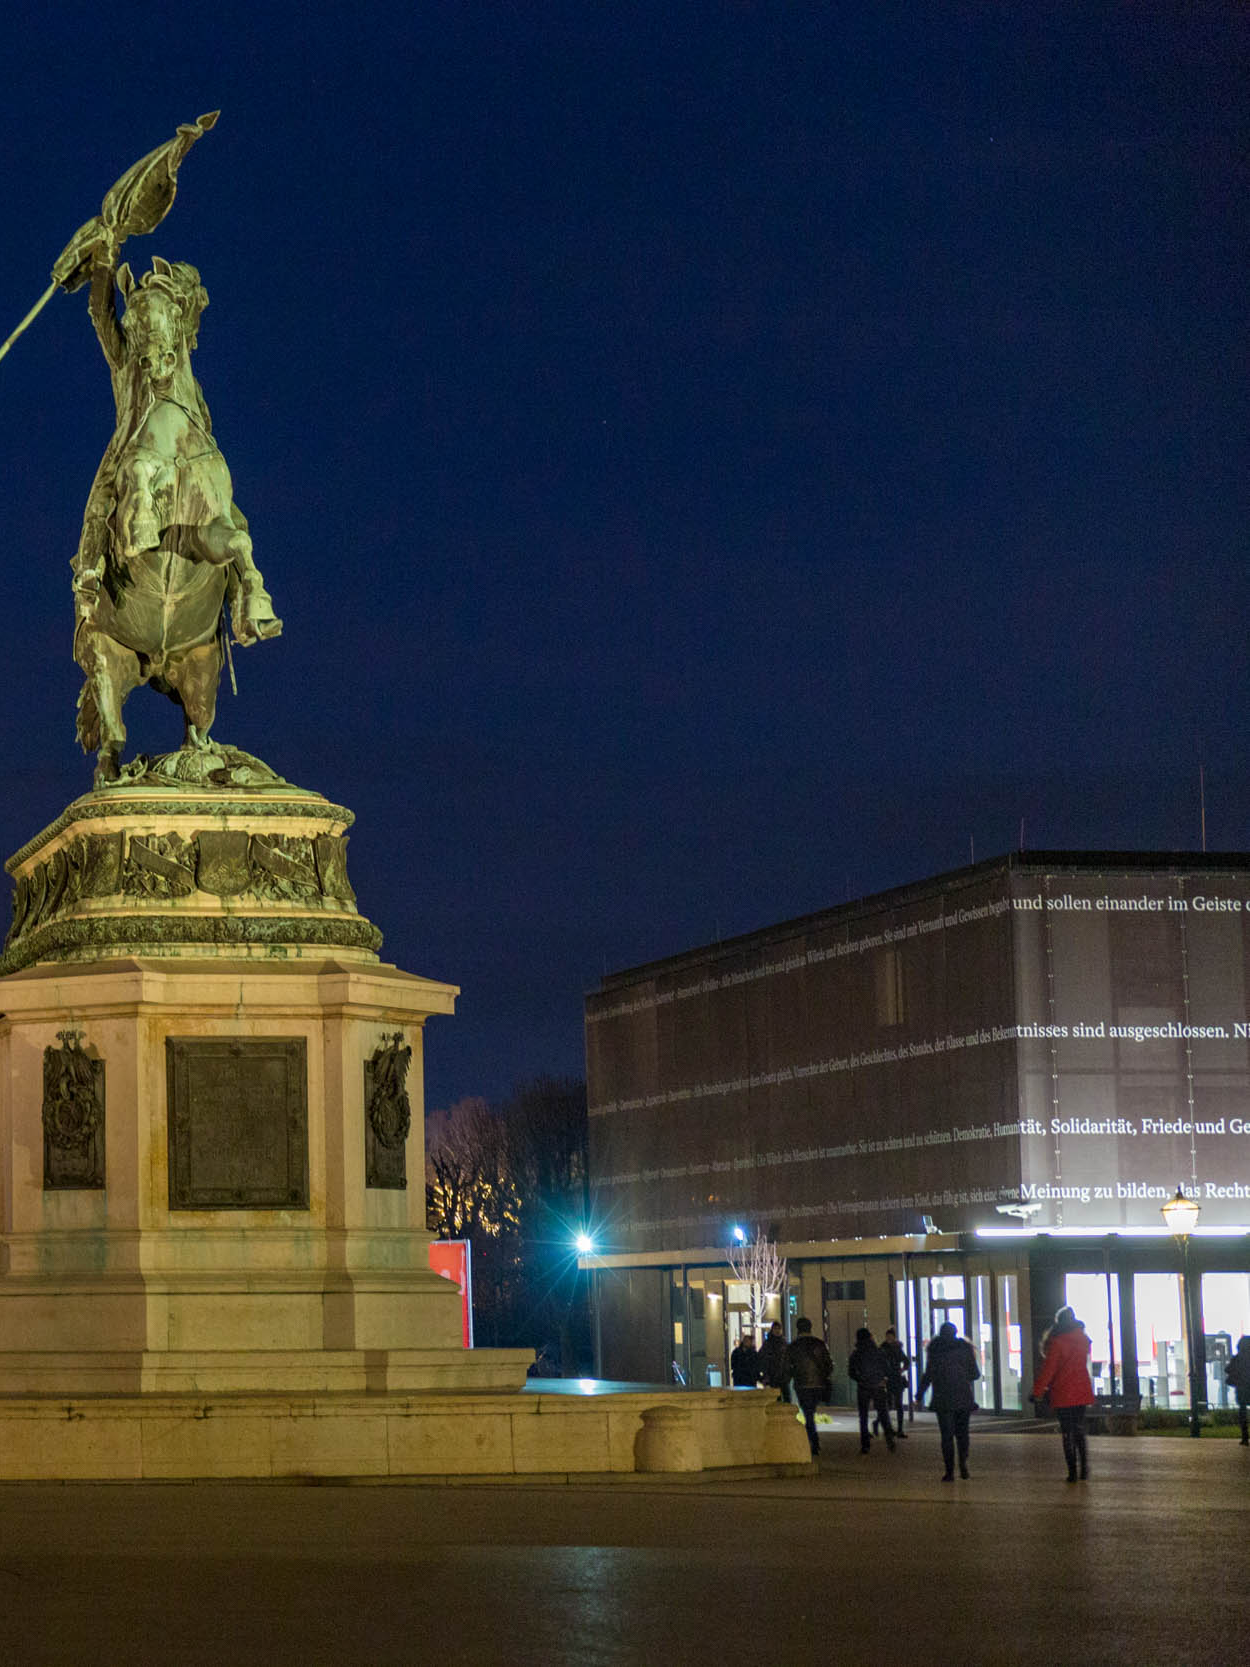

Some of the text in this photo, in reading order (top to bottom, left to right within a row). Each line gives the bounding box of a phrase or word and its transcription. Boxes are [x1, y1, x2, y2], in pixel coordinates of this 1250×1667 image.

[1013, 895, 1043, 911] und
[1047, 895, 1092, 911] sollen
[1096, 896, 1164, 911] einander
[1168, 896, 1188, 911] im
[1193, 896, 1241, 911] Geiste
[1073, 1022, 1106, 1039] sind
[1110, 1023, 1230, 1042] ausgeschlossen.
[1051, 1118, 1137, 1136] Solidarität,
[1141, 1118, 1191, 1134] Friede
[1194, 1118, 1226, 1134] und
[1021, 1183, 1090, 1202] Meinung
[1094, 1186, 1113, 1198] zu
[1117, 1183, 1170, 1199] bilden,
[1205, 1182, 1250, 1198] Recht
